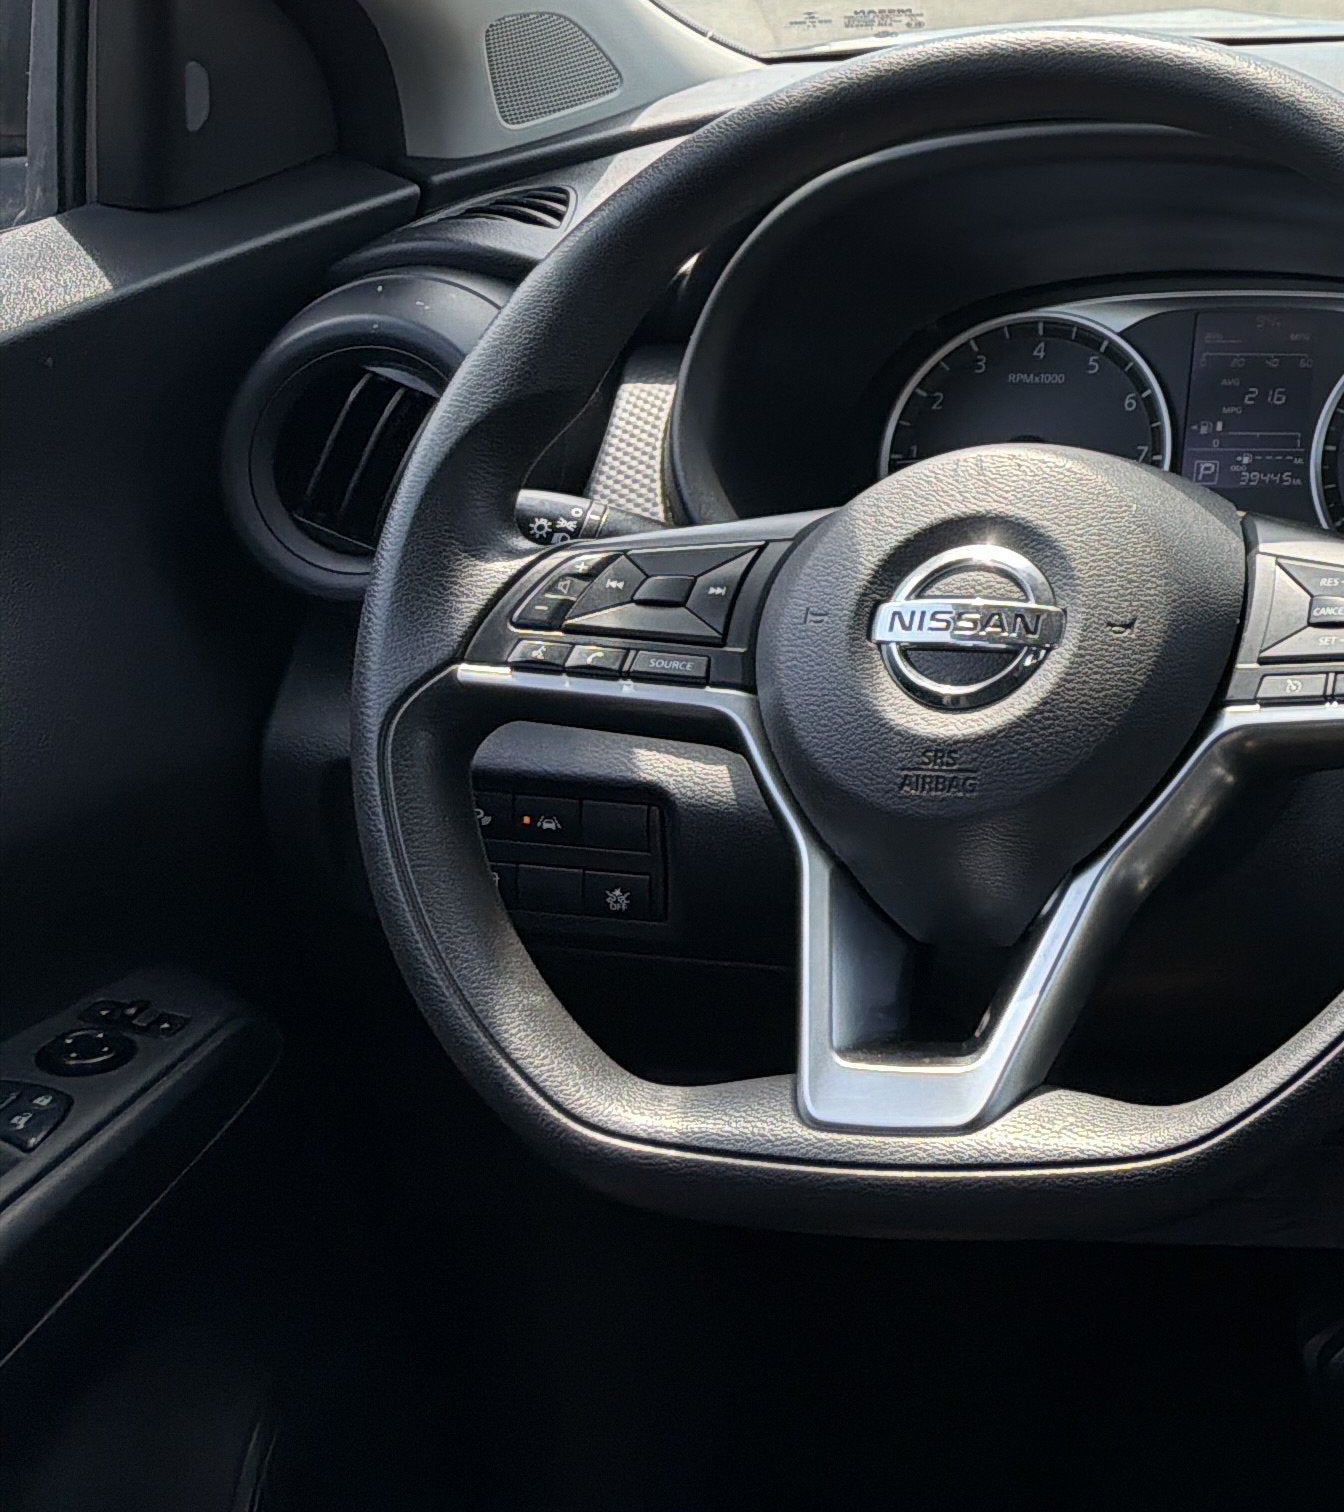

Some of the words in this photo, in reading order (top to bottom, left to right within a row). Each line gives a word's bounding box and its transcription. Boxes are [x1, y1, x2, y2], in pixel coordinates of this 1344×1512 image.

[1033, 342, 1046, 359] 4
[975, 355, 987, 374] 3
[1088, 356, 1100, 374] 5
[1008, 373, 1066, 384] RPMx1000
[1221, 378, 1240, 386] AVG
[931, 392, 944, 410] 2
[1124, 393, 1136, 411] 6
[1222, 406, 1243, 414] MPG
[1212, 439, 1219, 447] 0
[910, 445, 918, 457] 1
[1136, 445, 1149, 462] 7
[1198, 463, 1215, 481] P
[1240, 472, 1292, 486] 39445
[1319, 577, 1339, 587] RES
[888, 610, 1042, 637] NISSAN
[1319, 636, 1336, 645] SET
[649, 658, 694, 672] SOURCE
[920, 749, 958, 767] SRS
